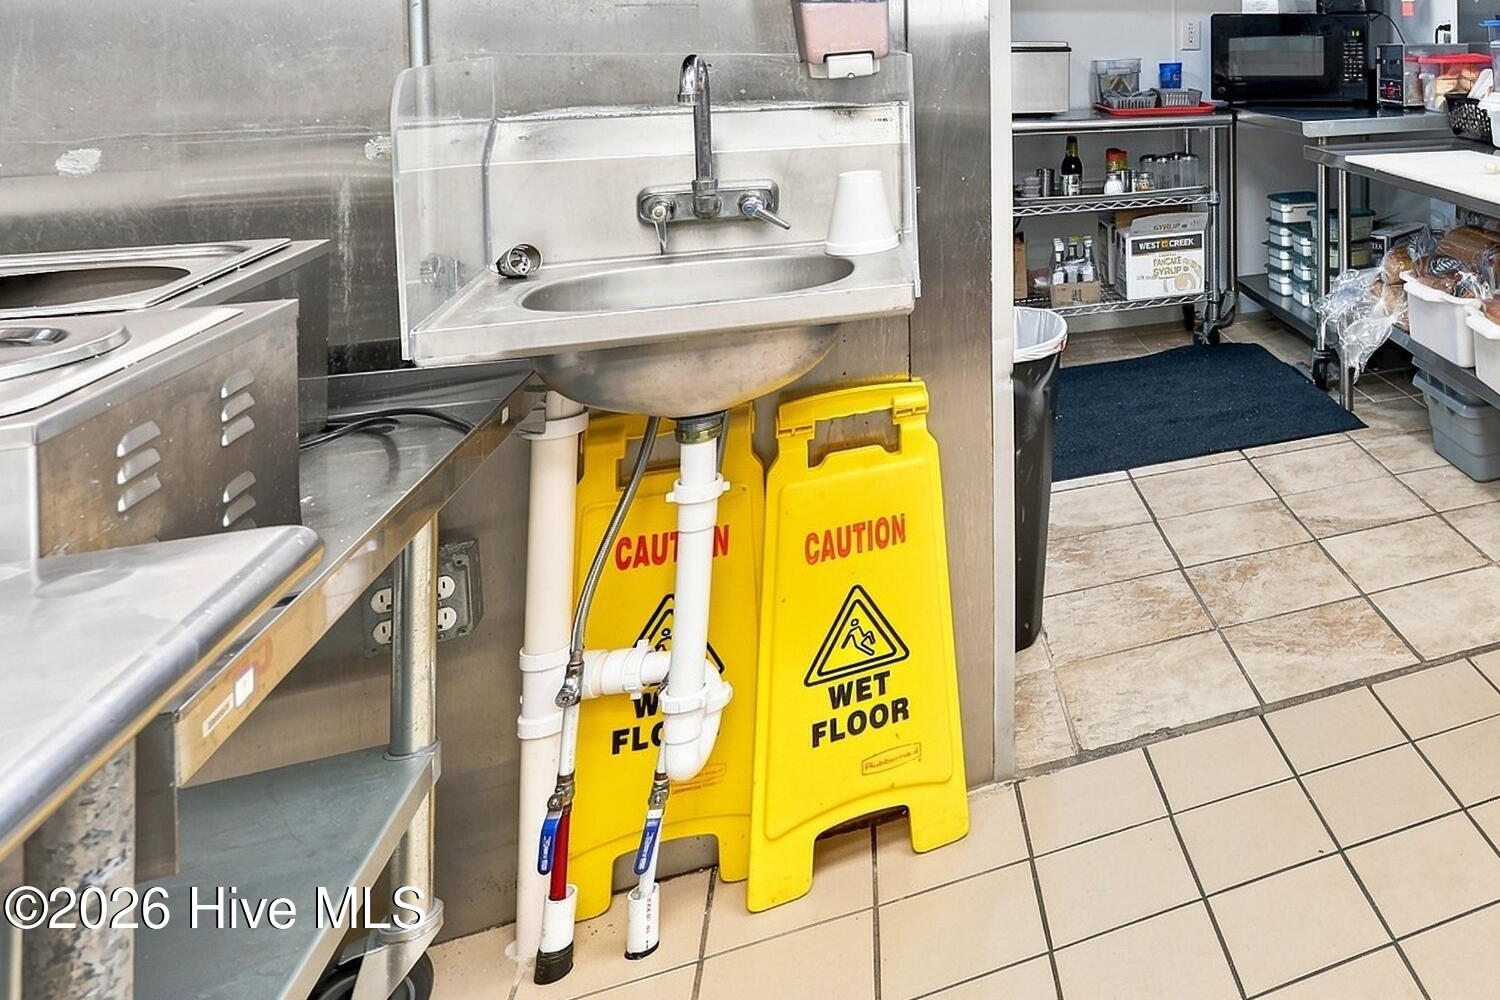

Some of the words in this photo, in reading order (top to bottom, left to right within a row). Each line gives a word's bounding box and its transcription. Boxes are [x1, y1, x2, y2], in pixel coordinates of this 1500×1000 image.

[1138, 241, 1160, 251] WEST
[1168, 238, 1194, 248] CREEK
[1153, 256, 1182, 267] PANCAKE
[1153, 266, 1182, 277] SYRUP
[615, 525, 730, 571] CAUTN
[804, 513, 906, 566] CAUTION
[828, 670, 891, 710] WET
[812, 697, 910, 748] FLOOR
